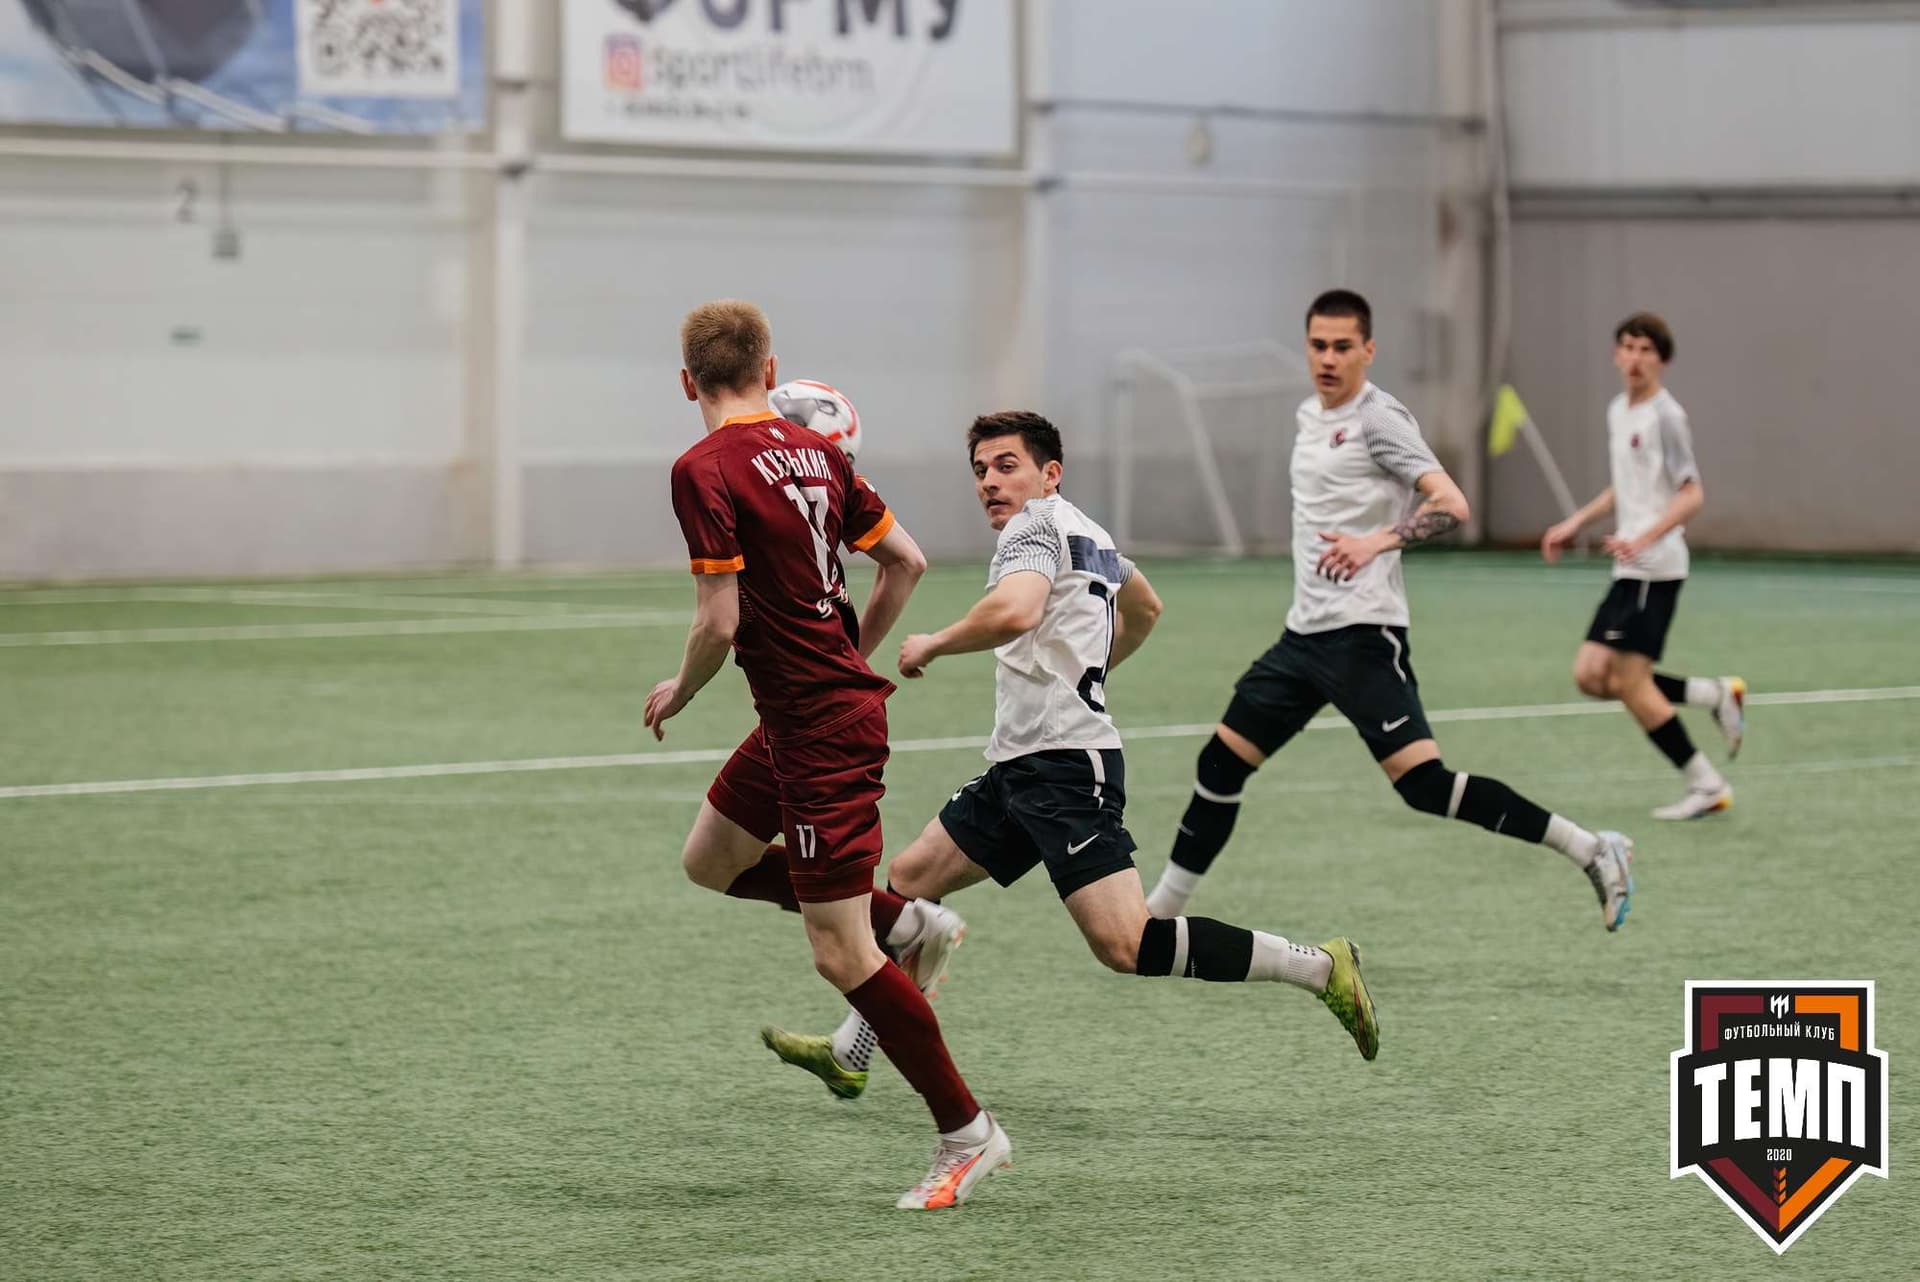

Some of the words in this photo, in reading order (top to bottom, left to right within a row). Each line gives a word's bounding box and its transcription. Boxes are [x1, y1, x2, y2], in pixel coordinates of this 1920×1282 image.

[751, 447, 832, 486] КУЗЬКИН
[783, 483, 832, 594] 17
[796, 824, 816, 858] 17
